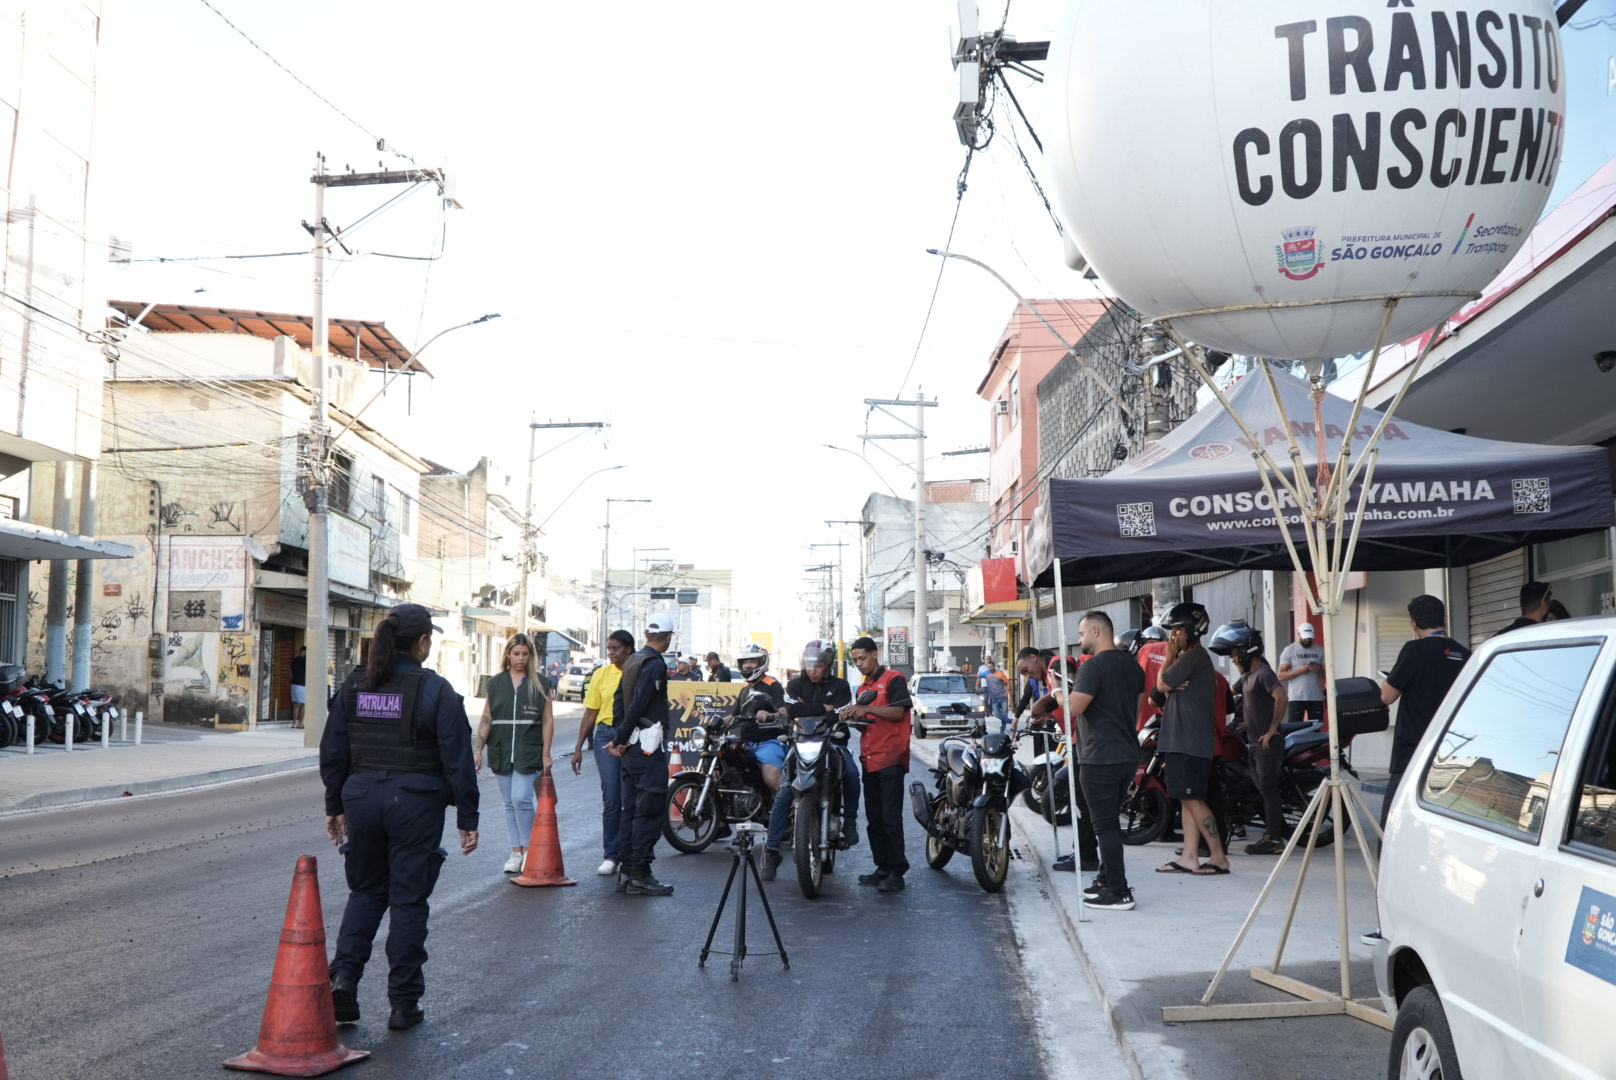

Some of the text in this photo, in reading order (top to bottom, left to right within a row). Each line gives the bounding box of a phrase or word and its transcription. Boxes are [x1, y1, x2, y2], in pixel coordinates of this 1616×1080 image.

[1275, 0, 1560, 101] TRÂNSITO
[1232, 107, 1563, 206] CONSCIENTE
[1341, 234, 1392, 243] PREFEITURA
[1393, 232, 1431, 241] MUNICIPAL
[1331, 242, 1443, 261] SÃO GONÇALO
[1234, 420, 1410, 450] YAMAHA
[1360, 480, 1495, 504] YAMAHA
[1207, 507, 1454, 531] www.consoamaha.com.br
[358, 694, 400, 711] PATRULHA
[1600, 912, 1614, 930] SÃO
